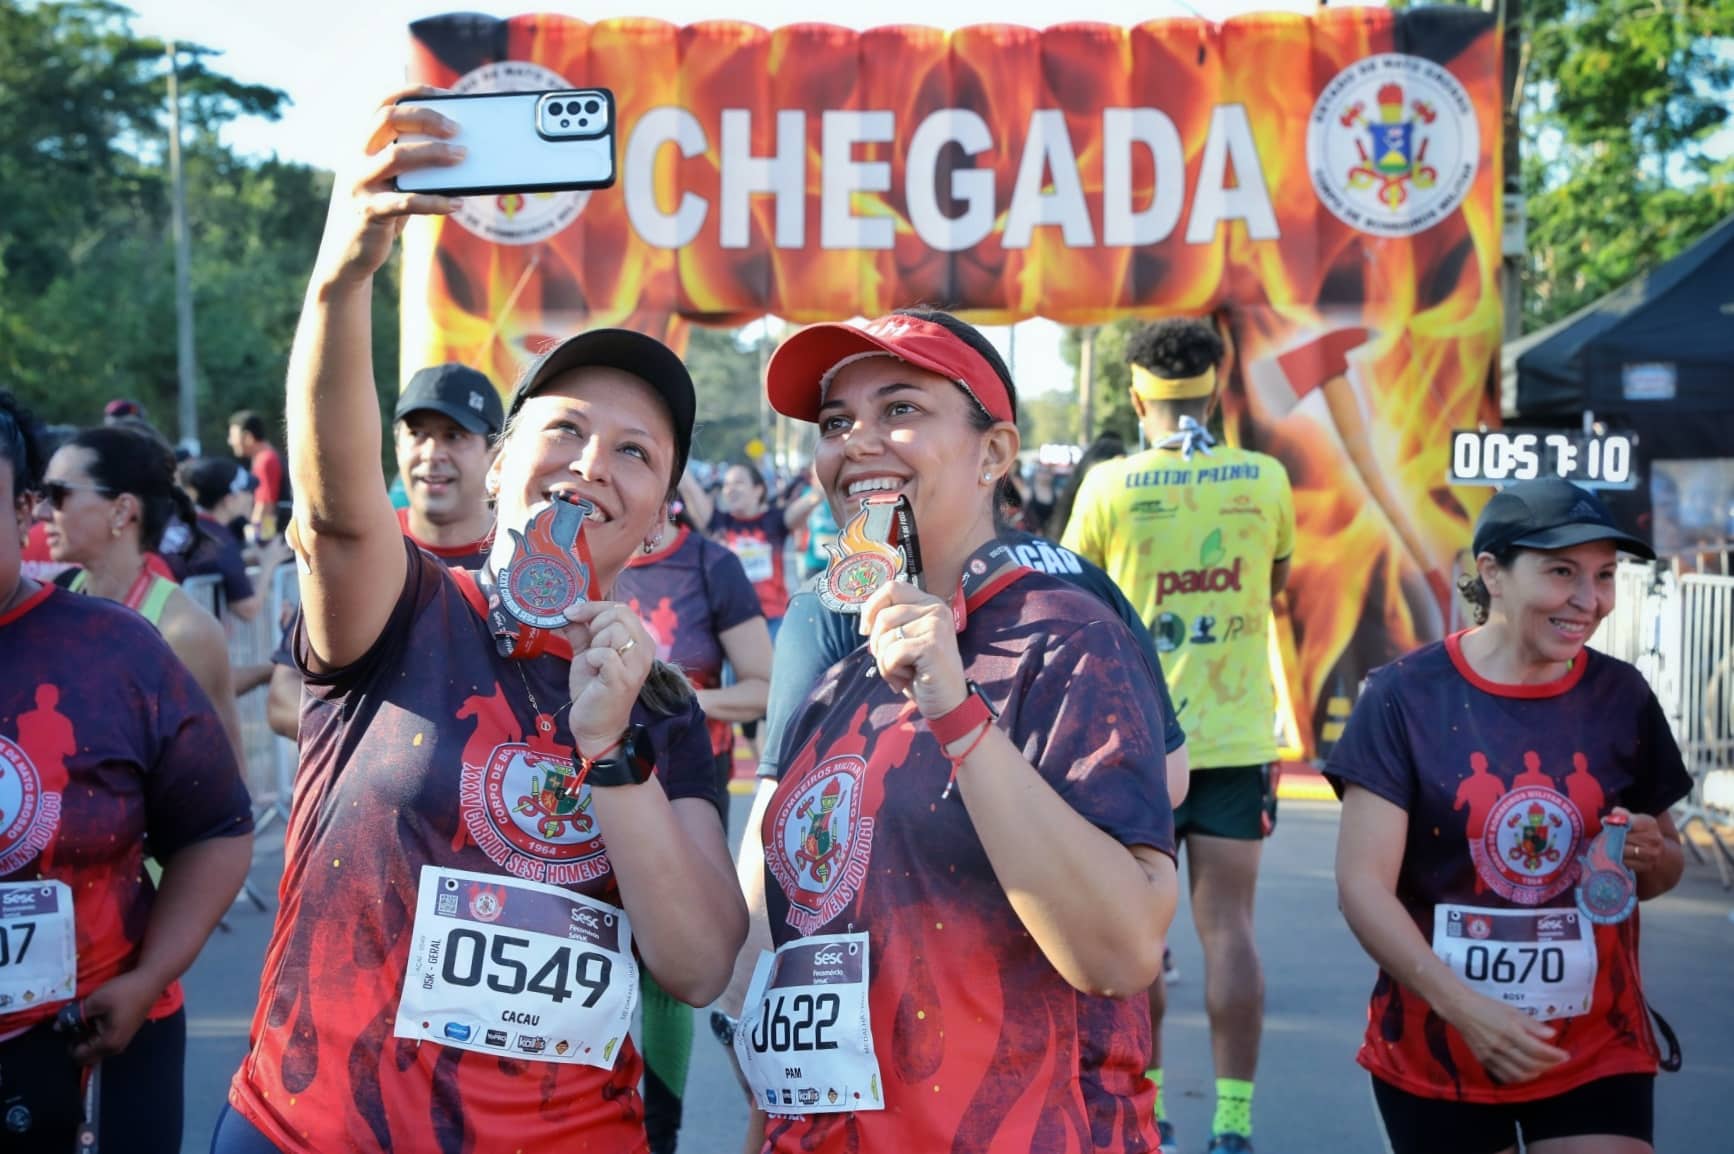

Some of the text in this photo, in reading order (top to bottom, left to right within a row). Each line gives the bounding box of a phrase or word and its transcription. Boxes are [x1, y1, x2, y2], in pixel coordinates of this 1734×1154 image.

[623, 106, 1279, 252] CHEGADA
[1454, 433, 1630, 482] 00:57:10
[490, 763, 508, 824] CORPO DE
[778, 766, 832, 826] BOMBEIROS
[0, 842, 38, 876] MENS
[464, 806, 512, 867] CORRIDA
[506, 852, 545, 881] SESC
[546, 855, 611, 884] HOMENS
[528, 841, 557, 855] 1964
[853, 816, 874, 865] FOGO
[842, 860, 866, 891] DO
[428, 938, 442, 964] GERAL
[442, 928, 612, 1009] 0549
[1465, 945, 1564, 984] 0670
[501, 1010, 540, 1026] CACAU
[752, 993, 841, 1053] 0622
[785, 1067, 802, 1079] PAM
